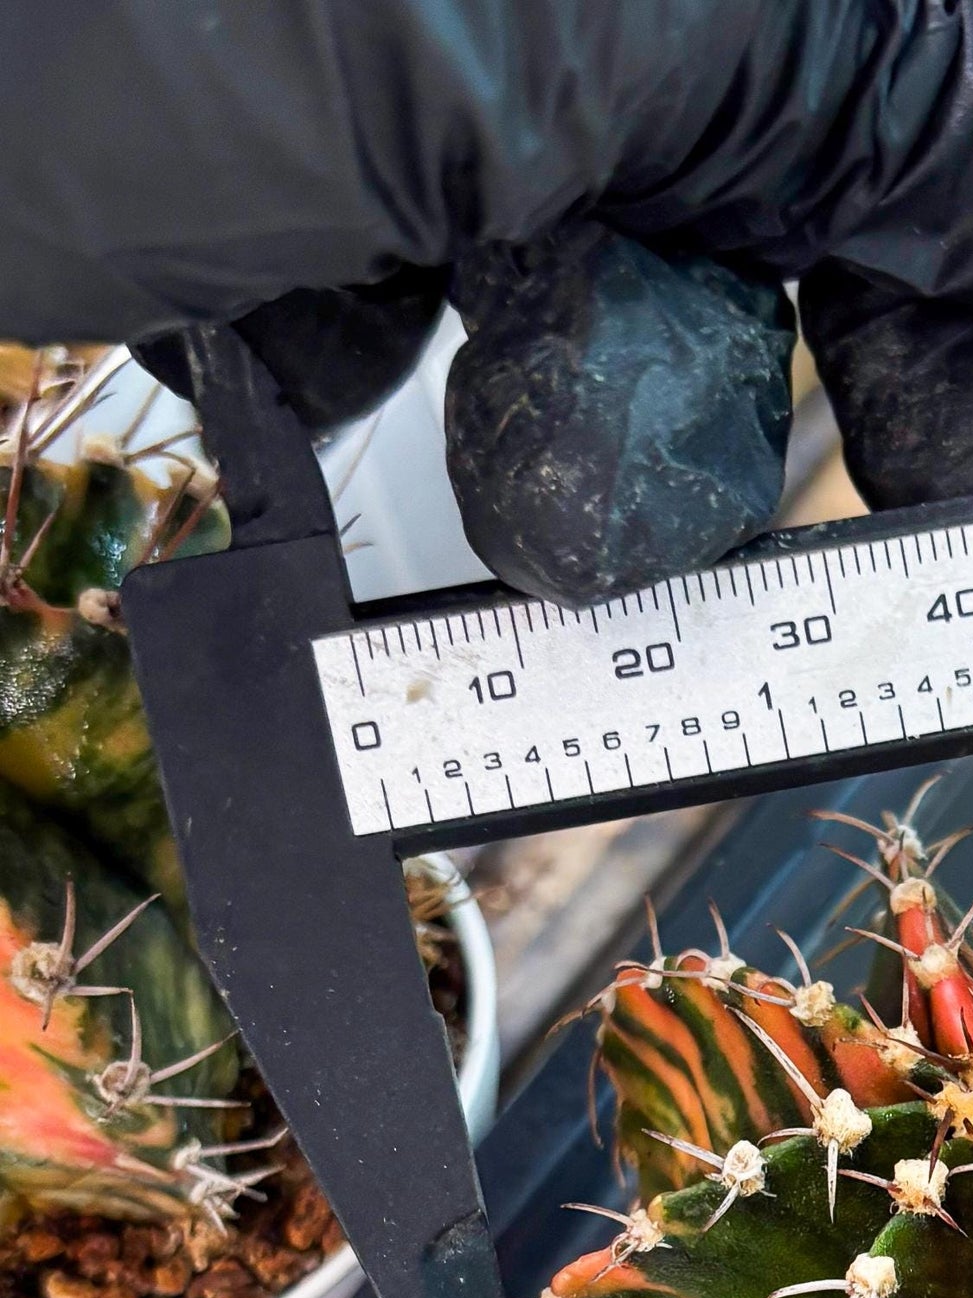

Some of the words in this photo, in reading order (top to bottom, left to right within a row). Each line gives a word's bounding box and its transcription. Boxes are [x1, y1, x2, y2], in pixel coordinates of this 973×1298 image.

[351, 720, 382, 751] 0
[468, 670, 517, 704] 10
[611, 642, 676, 680] 20
[769, 614, 833, 651] 30
[411, 766, 421, 784] 1
[442, 759, 464, 780] 2
[482, 751, 503, 771] 3
[524, 744, 542, 764] 4
[561, 737, 582, 758] 5
[601, 730, 622, 751] 6
[644, 723, 661, 743] 7
[680, 716, 702, 737] 8
[720, 710, 741, 731] 9
[757, 681, 774, 711] 1
[807, 696, 818, 715] 1
[838, 689, 859, 709] 2
[876, 681, 896, 701] 3
[916, 674, 934, 694] 4
[953, 668, 972, 688] 5
